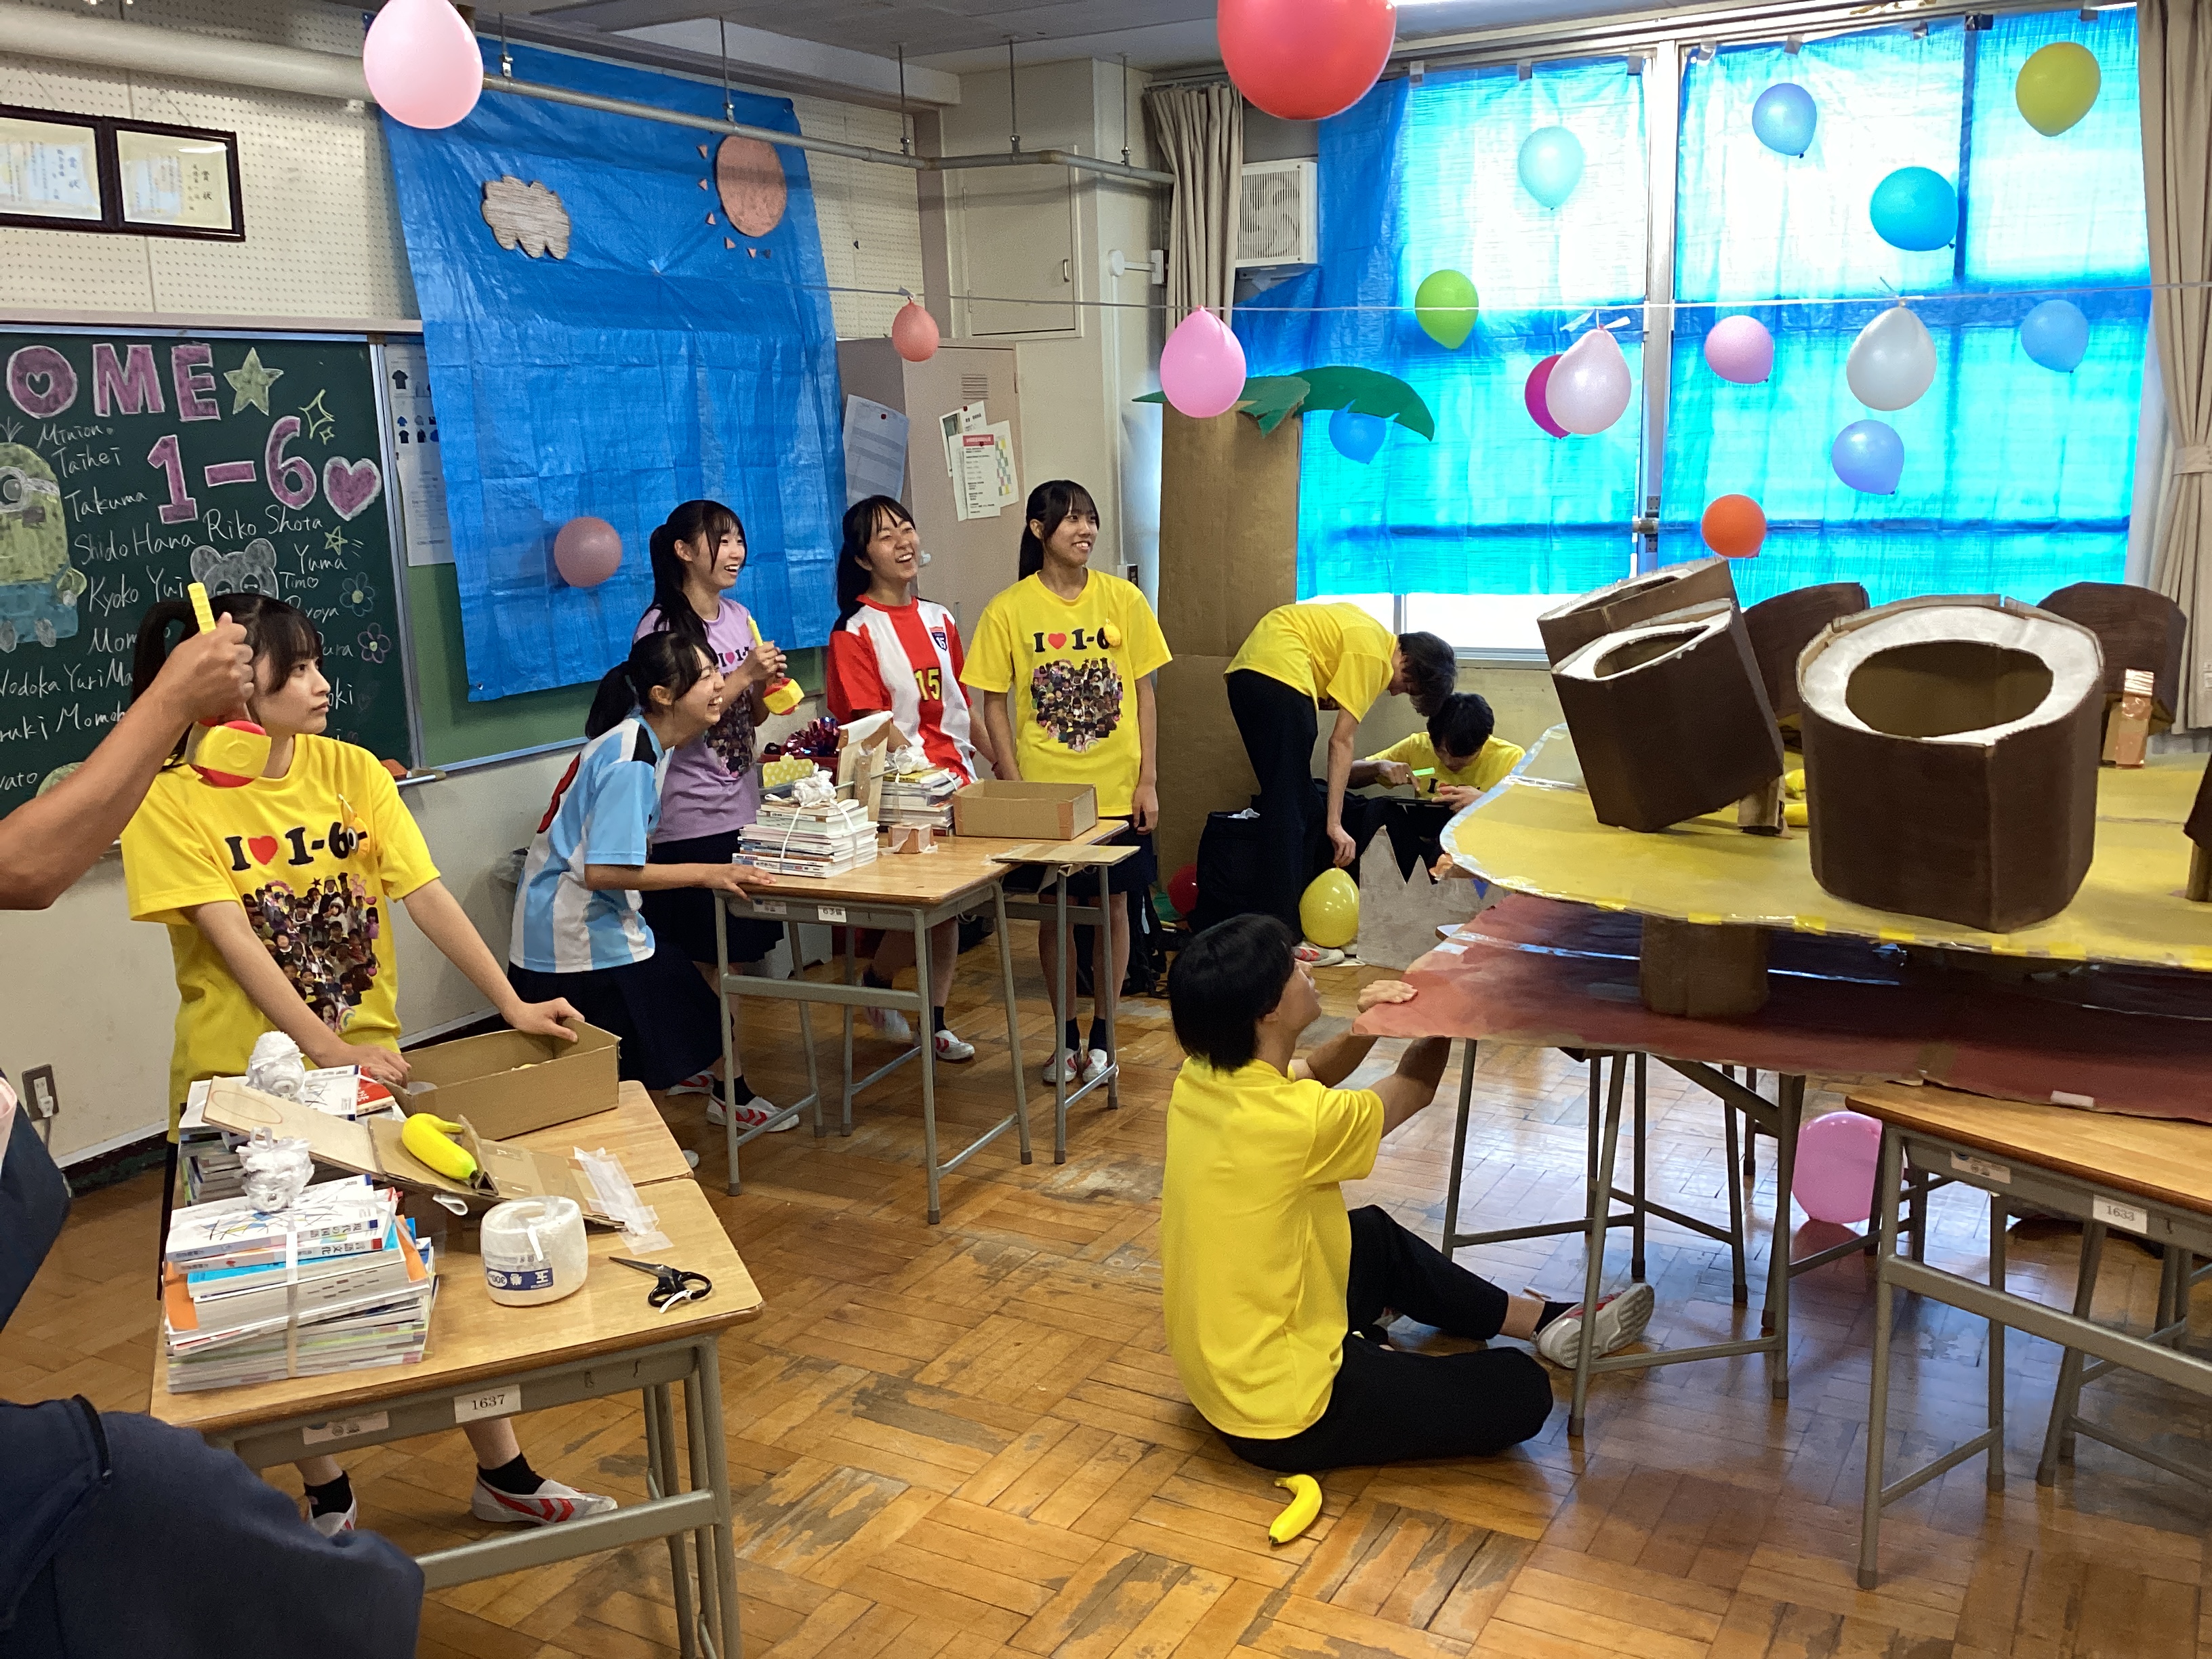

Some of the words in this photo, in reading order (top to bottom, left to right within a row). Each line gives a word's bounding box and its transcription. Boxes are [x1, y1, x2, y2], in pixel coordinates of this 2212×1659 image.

[51, 445, 121, 478] Taihei
[147, 415, 317, 525] 1-6
[64, 487, 149, 523] Takuma
[75, 529, 127, 565] Shido
[132, 522, 196, 556] Hana
[203, 508, 257, 542] Riko
[265, 504, 323, 535] Shota
[89, 573, 139, 617] Kyoko
[146, 565, 184, 603] Yui
[293, 543, 348, 575] Yuma
[63, 663, 103, 693] Yuri
[914, 667, 941, 701] 15
[225, 836, 251, 872] I
[470, 1394, 506, 1410] 1637
